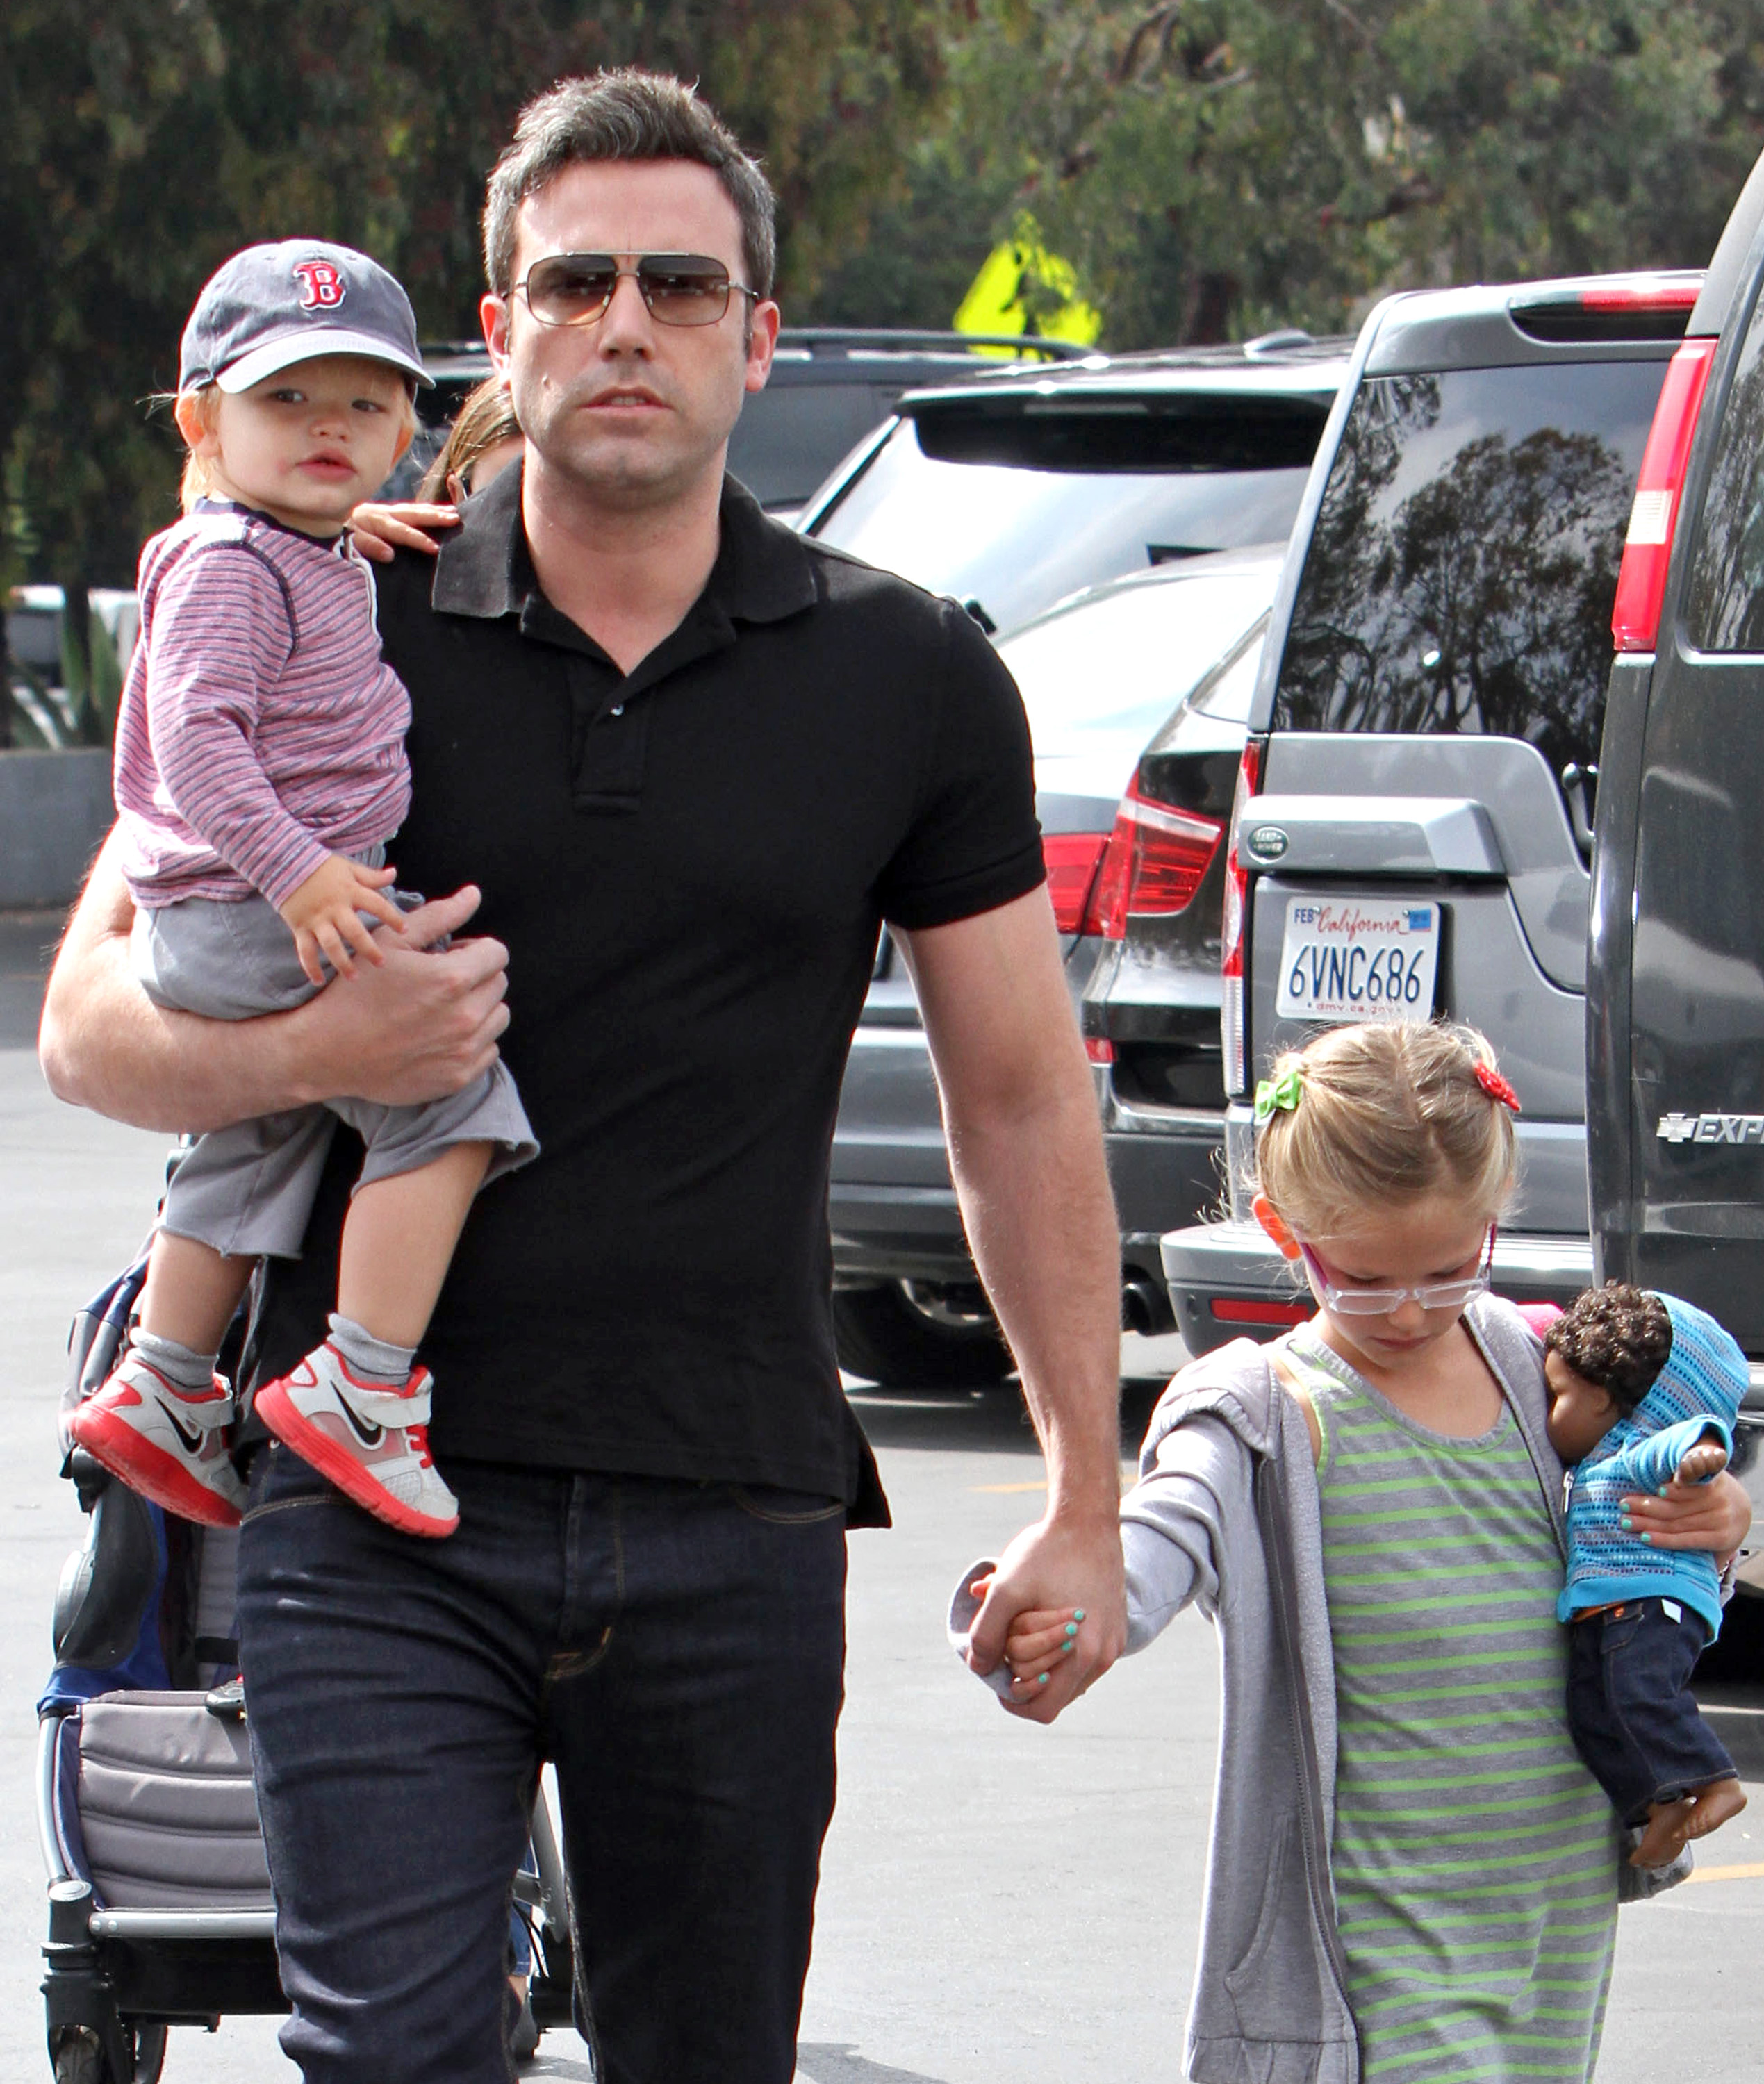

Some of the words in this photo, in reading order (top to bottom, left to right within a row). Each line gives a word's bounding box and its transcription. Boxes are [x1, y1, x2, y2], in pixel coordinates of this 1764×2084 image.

[292, 260, 346, 311] B
[1294, 909, 1314, 923] FEB
[1317, 907, 1408, 941] California
[1289, 945, 1424, 1003] 6VNC686
[1693, 1114, 1764, 1143] EXP
